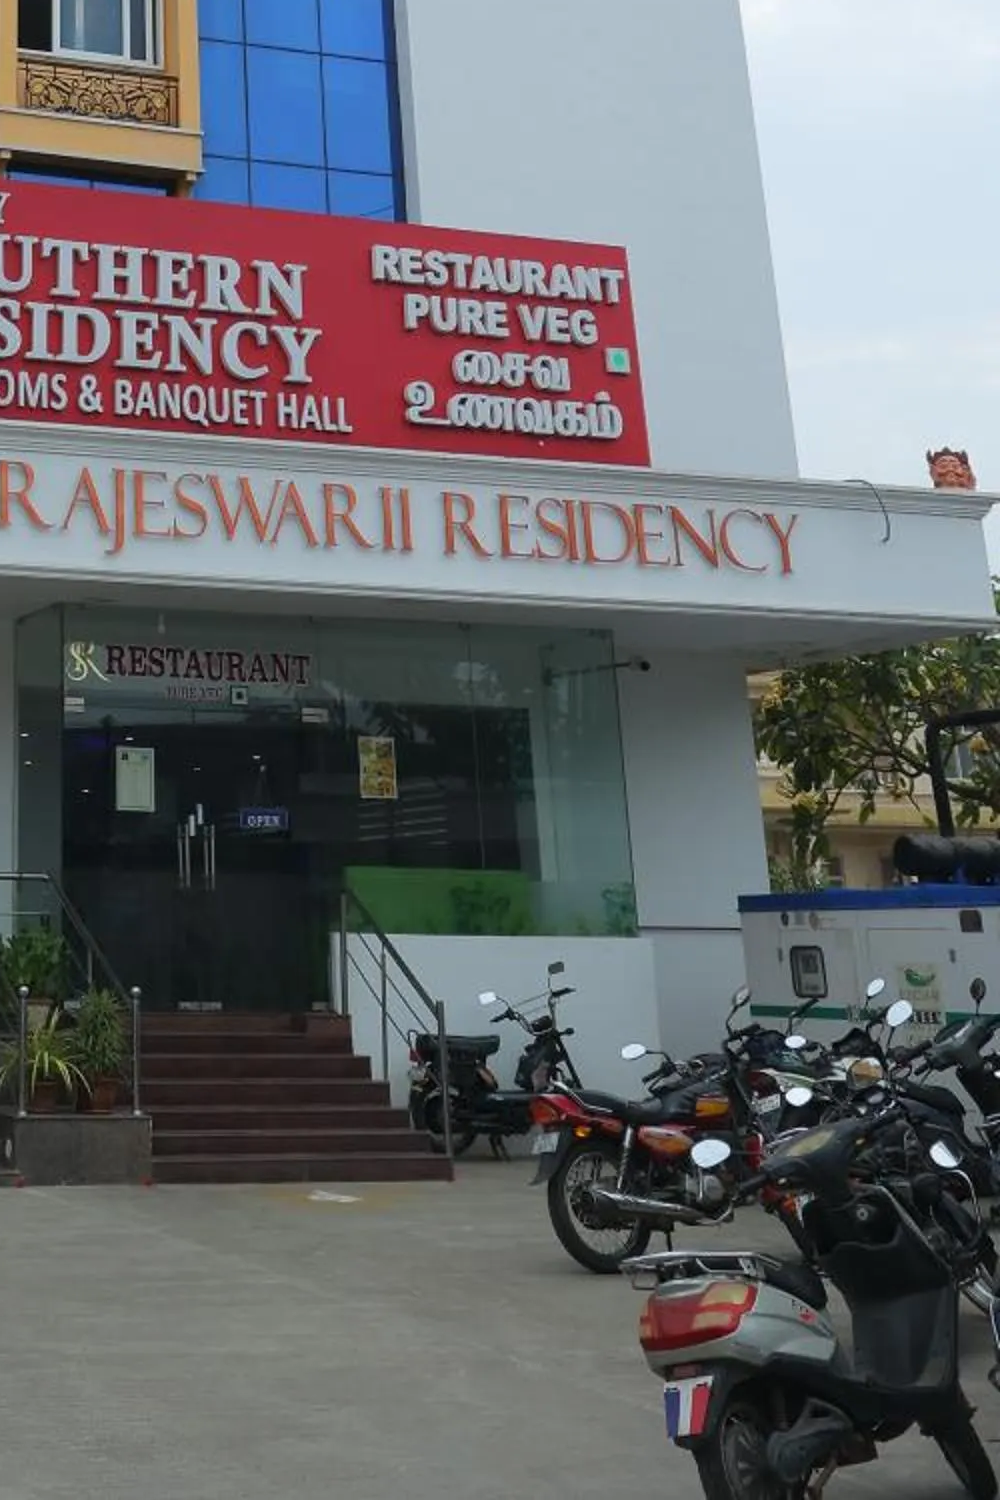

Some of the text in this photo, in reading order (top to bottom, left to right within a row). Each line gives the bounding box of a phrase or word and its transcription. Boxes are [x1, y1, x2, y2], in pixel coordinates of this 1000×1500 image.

[371, 243, 625, 306] RESTAURANT
[403, 293, 599, 347] PURE VEG
[452, 349, 572, 393] சைவ
[77, 378, 103, 414] &
[114, 378, 268, 428] BANQUET
[277, 392, 354, 434] HALL
[403, 380, 623, 441] உணவகம்
[438, 490, 800, 576] RESIDENCY
[104, 644, 312, 686] RESTAURANT
